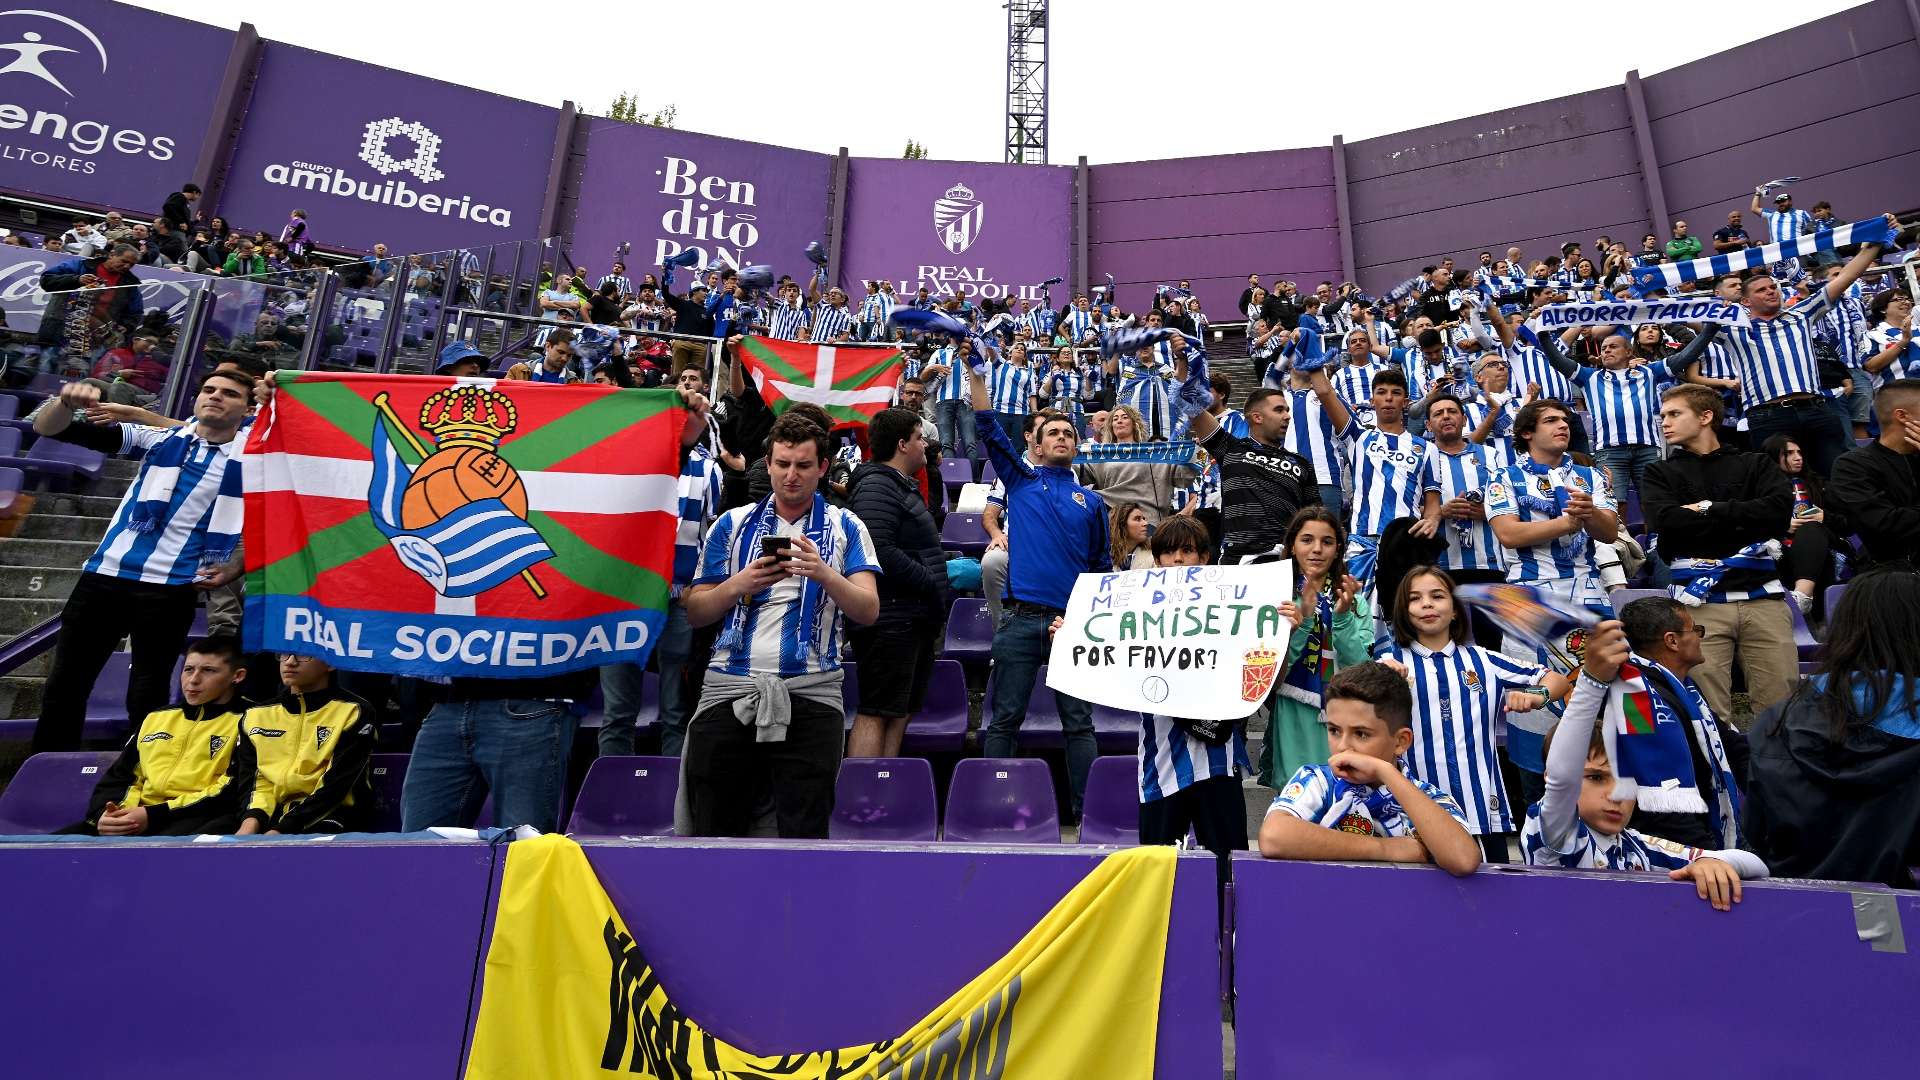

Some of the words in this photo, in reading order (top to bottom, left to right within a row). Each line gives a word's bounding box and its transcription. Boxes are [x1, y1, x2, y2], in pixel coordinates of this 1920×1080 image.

[0, 143, 97, 174] LTORES
[291, 160, 334, 174] GRUPO
[658, 156, 757, 206] Ben
[263, 162, 512, 228] ambuiberica
[917, 265, 993, 286] REAL
[1542, 305, 1635, 327] ALGORRI
[1646, 302, 1739, 322] TALDEA
[1245, 451, 1302, 477] CAZOO
[1369, 442, 1416, 465] CAZOO
[28, 576, 43, 592] 5
[1100, 567, 1225, 592] REMIRO
[1091, 591, 1132, 612] ME
[1151, 587, 1203, 605] DAS
[1215, 584, 1248, 601] TU
[284, 607, 373, 658] REAL
[390, 620, 649, 667] SOCIEDAD
[1072, 645, 1116, 667] POR
[1128, 645, 1217, 670] FAVOR?
